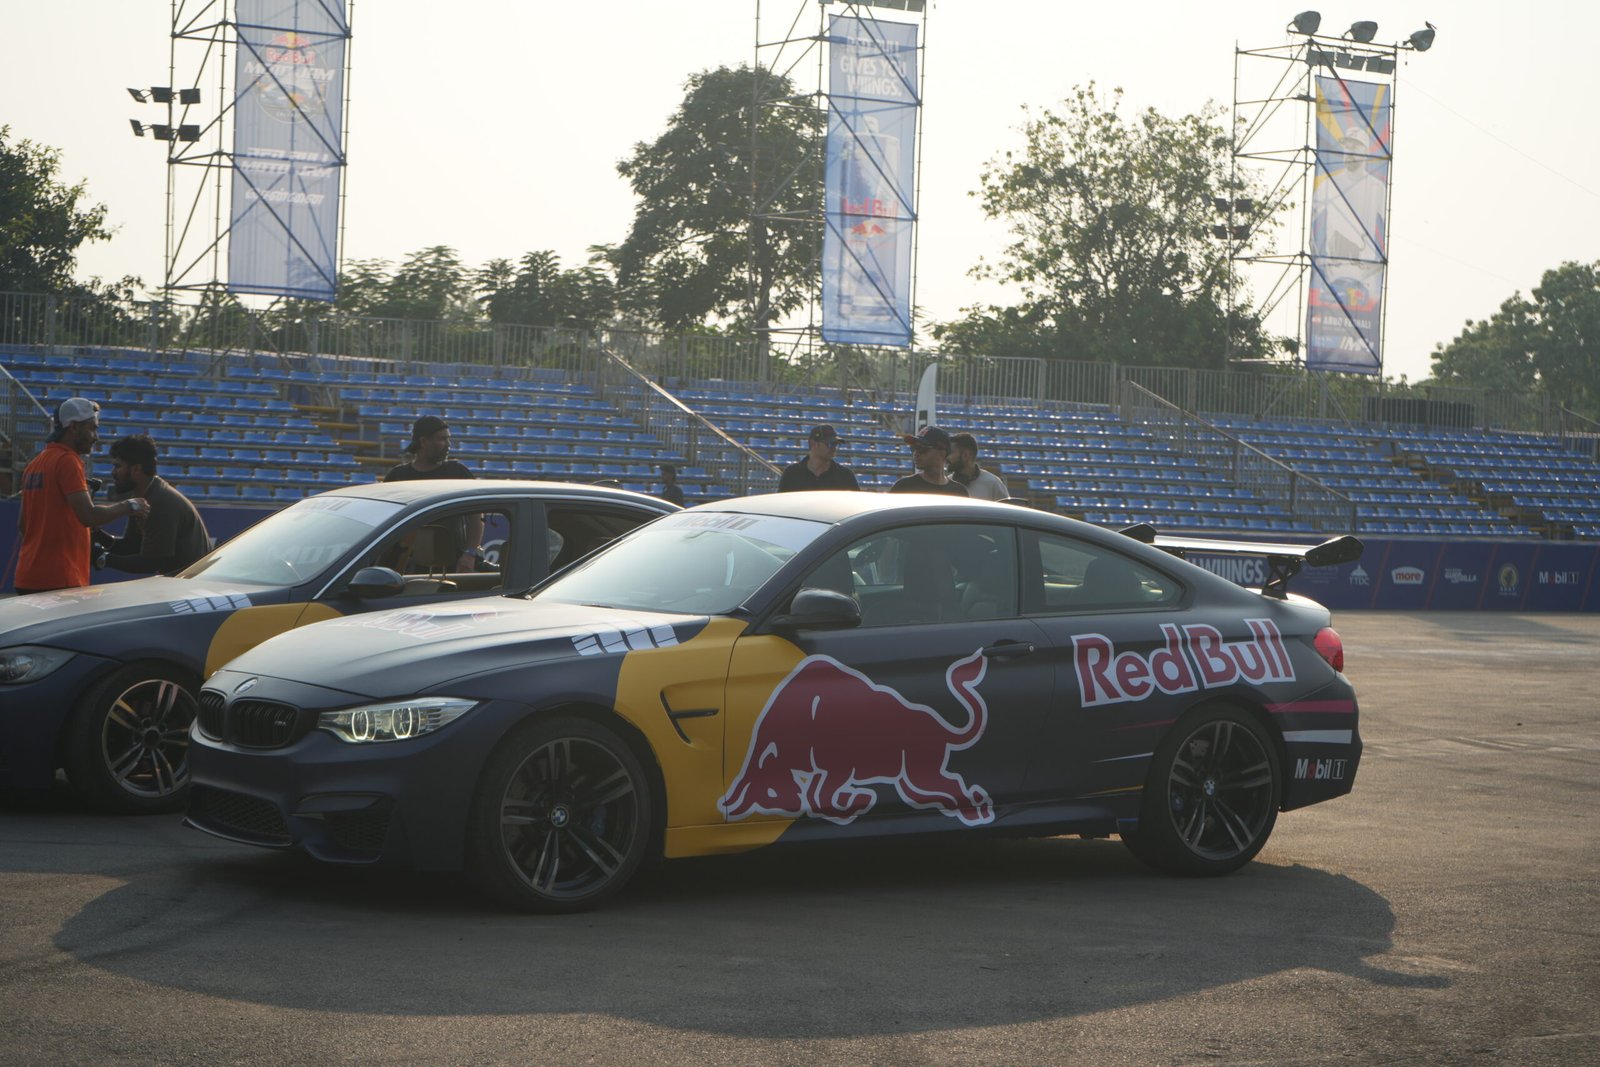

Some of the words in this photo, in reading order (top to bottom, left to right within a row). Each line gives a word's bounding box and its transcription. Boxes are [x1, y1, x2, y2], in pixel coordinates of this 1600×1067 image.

[841, 56, 877, 76] GIVES
[880, 59, 907, 79] YOU
[1395, 573, 1421, 582] more
[1539, 571, 1567, 585] Mobil
[1294, 758, 1332, 780] Mobil
